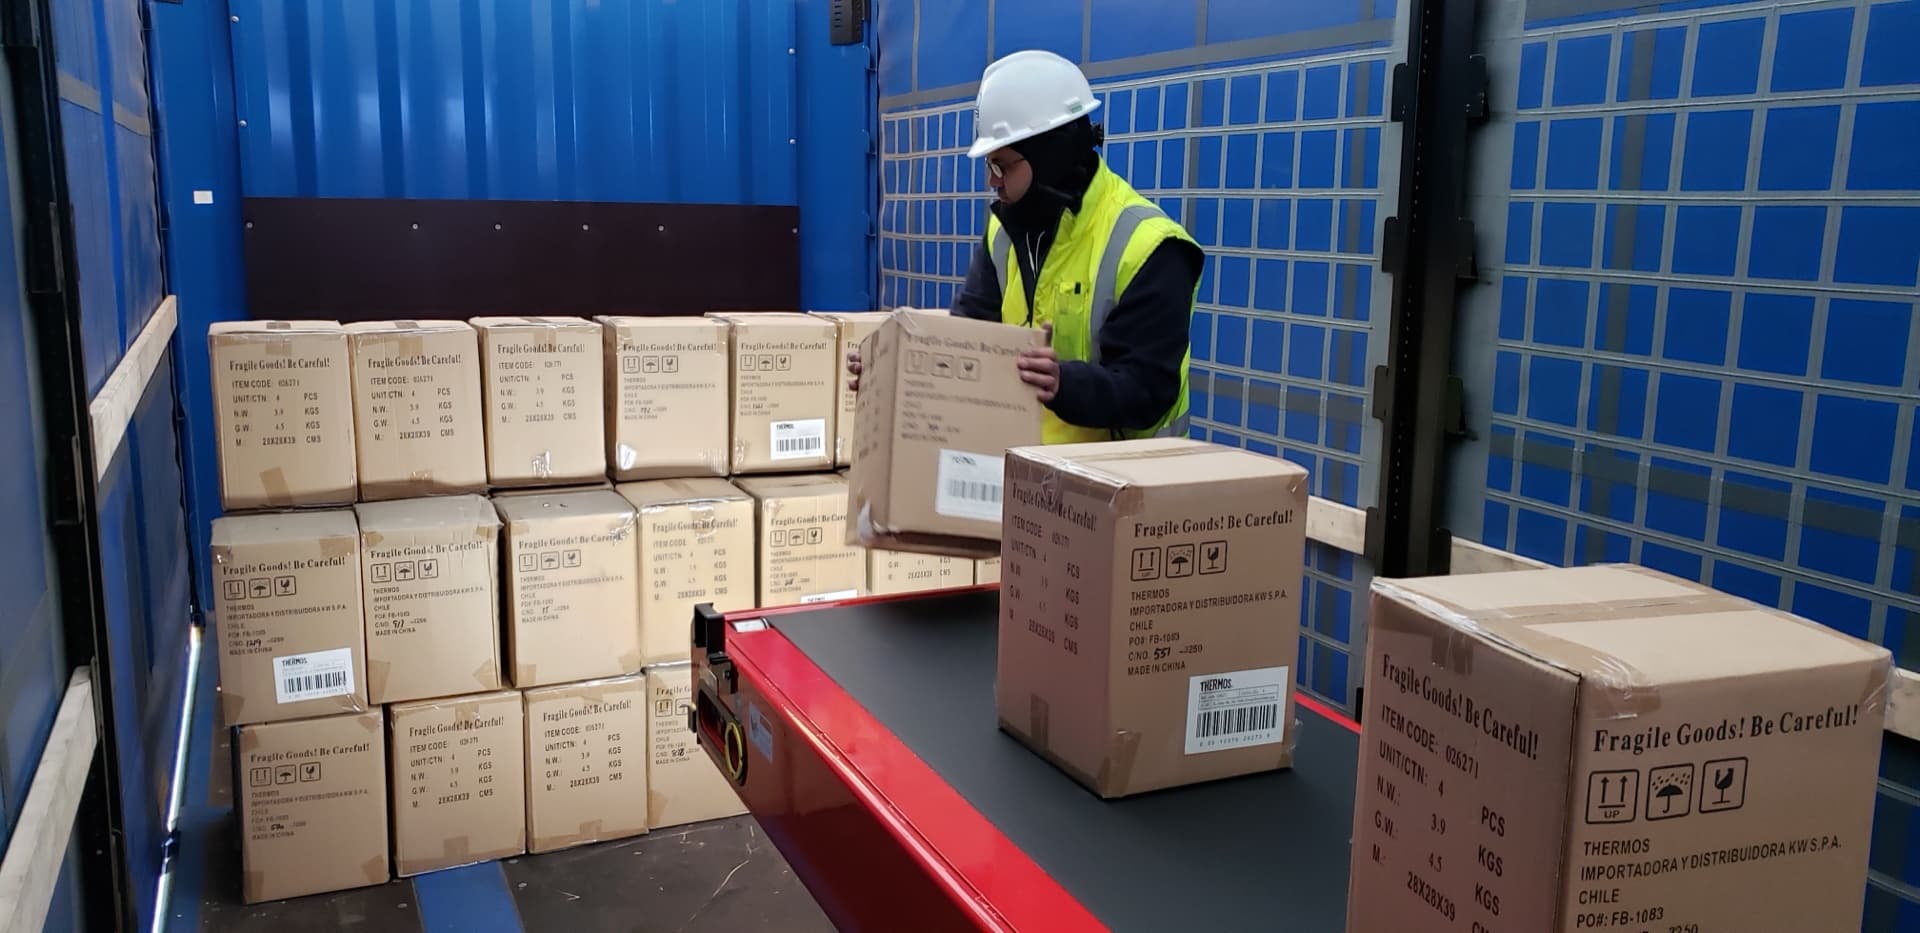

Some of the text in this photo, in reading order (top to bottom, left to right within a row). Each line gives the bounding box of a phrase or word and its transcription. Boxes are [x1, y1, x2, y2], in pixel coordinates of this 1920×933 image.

[497, 344, 522, 354] Fragile
[524, 343, 547, 353] Goods!
[558, 343, 584, 353] Careful!
[623, 343, 717, 352] Fragile Goods! Be Careful!
[741, 342, 764, 350] Fragile
[766, 342, 789, 350] Goods!
[230, 358, 330, 372] Fragile Goods! Be Careful!
[368, 354, 461, 369] Fragile Goods! Be Careful!
[499, 361, 513, 369] ITEM
[232, 380, 249, 388] ITEM
[370, 377, 386, 385] ITEM
[437, 387, 451, 396] PCS
[562, 386, 575, 394] KGS
[304, 392, 318, 401] PCS
[439, 401, 452, 409] KGS
[562, 400, 575, 408] KGS
[305, 407, 319, 415] KGS
[440, 415, 453, 423] KGS
[306, 421, 320, 429] KGS
[441, 429, 454, 437] CMS
[306, 435, 321, 443] CMS
[771, 517, 795, 526] Fragile
[797, 516, 820, 524] Goods!
[1012, 515, 1026, 531] ITEM
[1067, 504, 1097, 531] Careful!
[652, 522, 676, 533] Fragile
[1134, 509, 1293, 539] Fragile Goods! Be Careful!
[519, 540, 548, 549] Fragile
[550, 537, 578, 546] Goods!
[653, 540, 668, 548] ITEM
[370, 541, 483, 559] Fragile Goods! Be Careful!
[223, 557, 345, 576] Fragile Goods! Be Careful!
[1067, 562, 1080, 579] PCS
[1065, 587, 1080, 605] KGS
[1131, 588, 1170, 601] THERMOS
[1130, 601, 1188, 616] IMPORTADORA
[1189, 600, 1194, 609] Y
[1196, 593, 1254, 609] DISTRIBUIDORA
[1064, 613, 1078, 630] KGS
[1129, 620, 1153, 632] CHILE
[1064, 637, 1078, 655] CMS
[282, 658, 308, 666] THERMOS
[1128, 661, 1186, 676] MADE IN CHINA
[1200, 678, 1232, 692] THERMOS
[657, 686, 681, 696] Fragile
[543, 699, 631, 722] Fragile Goods! Be Careful!
[1383, 654, 1539, 760] Fragile Goods! Be Careful!
[410, 716, 504, 737] Fragile Goods! Be Careful!
[1593, 704, 1858, 755] Fragile Goods! Be Careful!
[545, 729, 560, 738] ITEM
[1382, 704, 1479, 780] ITEM CODE: 026271
[250, 744, 370, 762] Fragile Goods! Be Careful!
[410, 744, 426, 752] ITEM
[478, 748, 491, 757] PCS
[608, 747, 621, 755] KGS
[478, 762, 492, 770] KGS
[609, 760, 622, 768] KGS
[479, 775, 492, 784] KGS
[609, 773, 622, 781] CMS
[479, 789, 494, 798] CMS
[1379, 740, 1505, 837] UNIT/CTN: 4 PCS
[1604, 809, 1620, 820] UP
[1377, 775, 1503, 877] N.W.: 3.9 KGS
[1584, 838, 1650, 856] THERMOS
[1375, 811, 1500, 917] G.W.: 4.5 KGS
[1581, 860, 1678, 881] IMPORTADORA
[1681, 856, 1689, 870] Y
[1690, 842, 1786, 868] DISTRIBUIDORA
[1408, 871, 1455, 922] 28X28X39
[1579, 888, 1620, 904] CHILE
[1577, 907, 1664, 928] PO#: FB-1083
